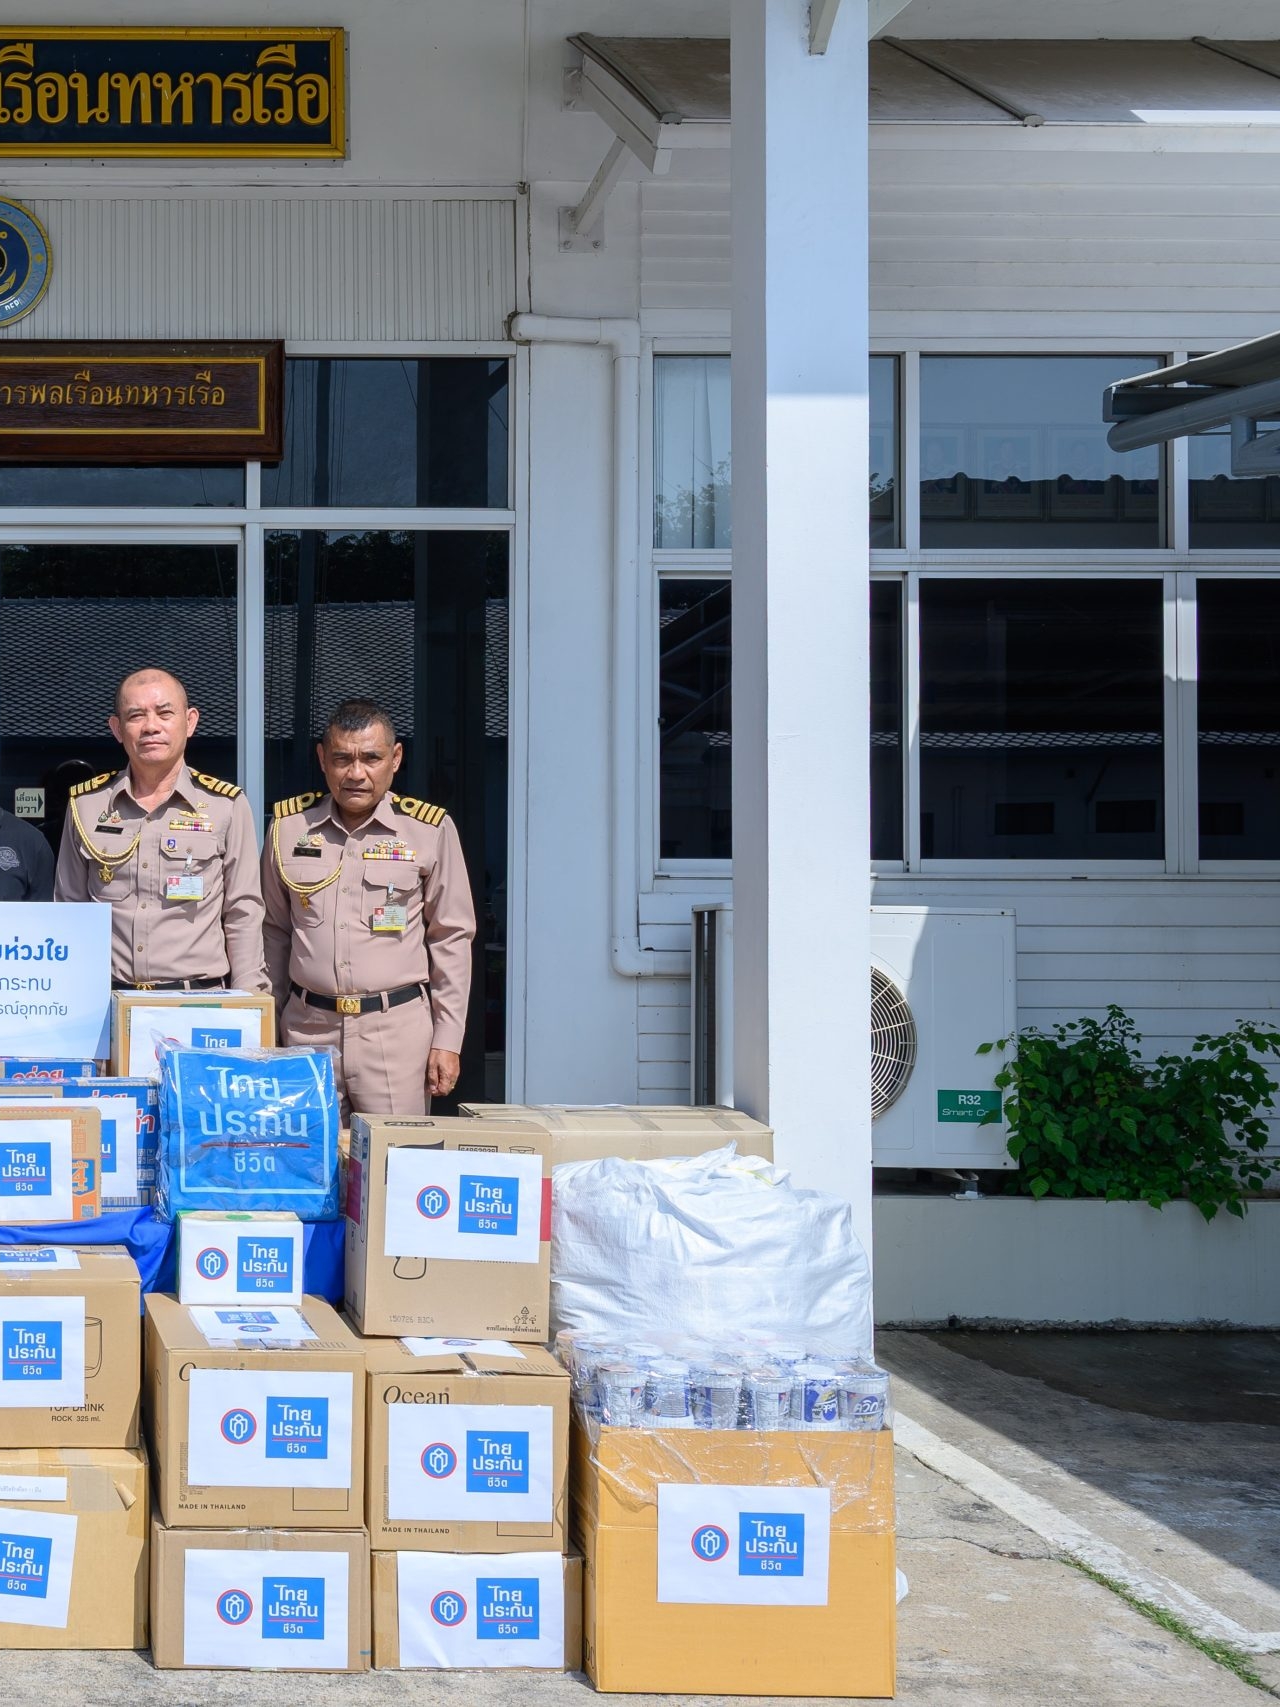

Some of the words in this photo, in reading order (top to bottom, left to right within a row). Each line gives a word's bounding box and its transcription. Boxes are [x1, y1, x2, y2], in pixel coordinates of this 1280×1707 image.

[16, 792, 38, 802] เลื่อน
[200, 1034, 228, 1048] ไทย
[205, 1065, 281, 1101] ไทย
[958, 1095, 981, 1105] R32
[942, 1108, 973, 1116] Smart
[5, 1149, 36, 1164] ไทย
[234, 1152, 276, 1173] ชีวิต
[2, 1163, 46, 1177] ประกัน
[15, 1182, 33, 1191] ชีวิต
[470, 1181, 503, 1200] ไทย
[464, 1198, 512, 1215] ประกัน
[478, 1218, 498, 1229] ชีวิต
[246, 1243, 278, 1259] ไทย
[242, 1258, 288, 1273] ประกัน
[255, 1278, 274, 1288] ชีวิต
[12, 1328, 46, 1345] ไทย
[8, 1344, 56, 1359] ประกัน
[23, 1365, 42, 1375] ชีวิต
[382, 1385, 450, 1405] Ocean
[277, 1404, 312, 1422] ไทย
[272, 1421, 322, 1437] ประกัน
[287, 1442, 307, 1453] ชีวิต
[477, 1438, 512, 1456] ไทย
[472, 1455, 523, 1471] ประกัน
[487, 1476, 508, 1488] ชีวิต
[382, 1526, 402, 1534] MADE
[404, 1526, 412, 1534] IN
[414, 1526, 450, 1534] THAILAND
[750, 1520, 787, 1538] ไทย
[1, 1540, 35, 1560] ไทย
[745, 1537, 798, 1554] ประกัน
[760, 1559, 782, 1571] ชีวิต
[7, 1579, 27, 1591] ชีวิต
[272, 1584, 308, 1602] ไทย
[486, 1585, 522, 1602] ไทย
[268, 1601, 318, 1617] ประกัน
[483, 1602, 533, 1618] ประกัน
[283, 1623, 303, 1633] ชีวิต
[498, 1623, 518, 1634] ชีวิต
